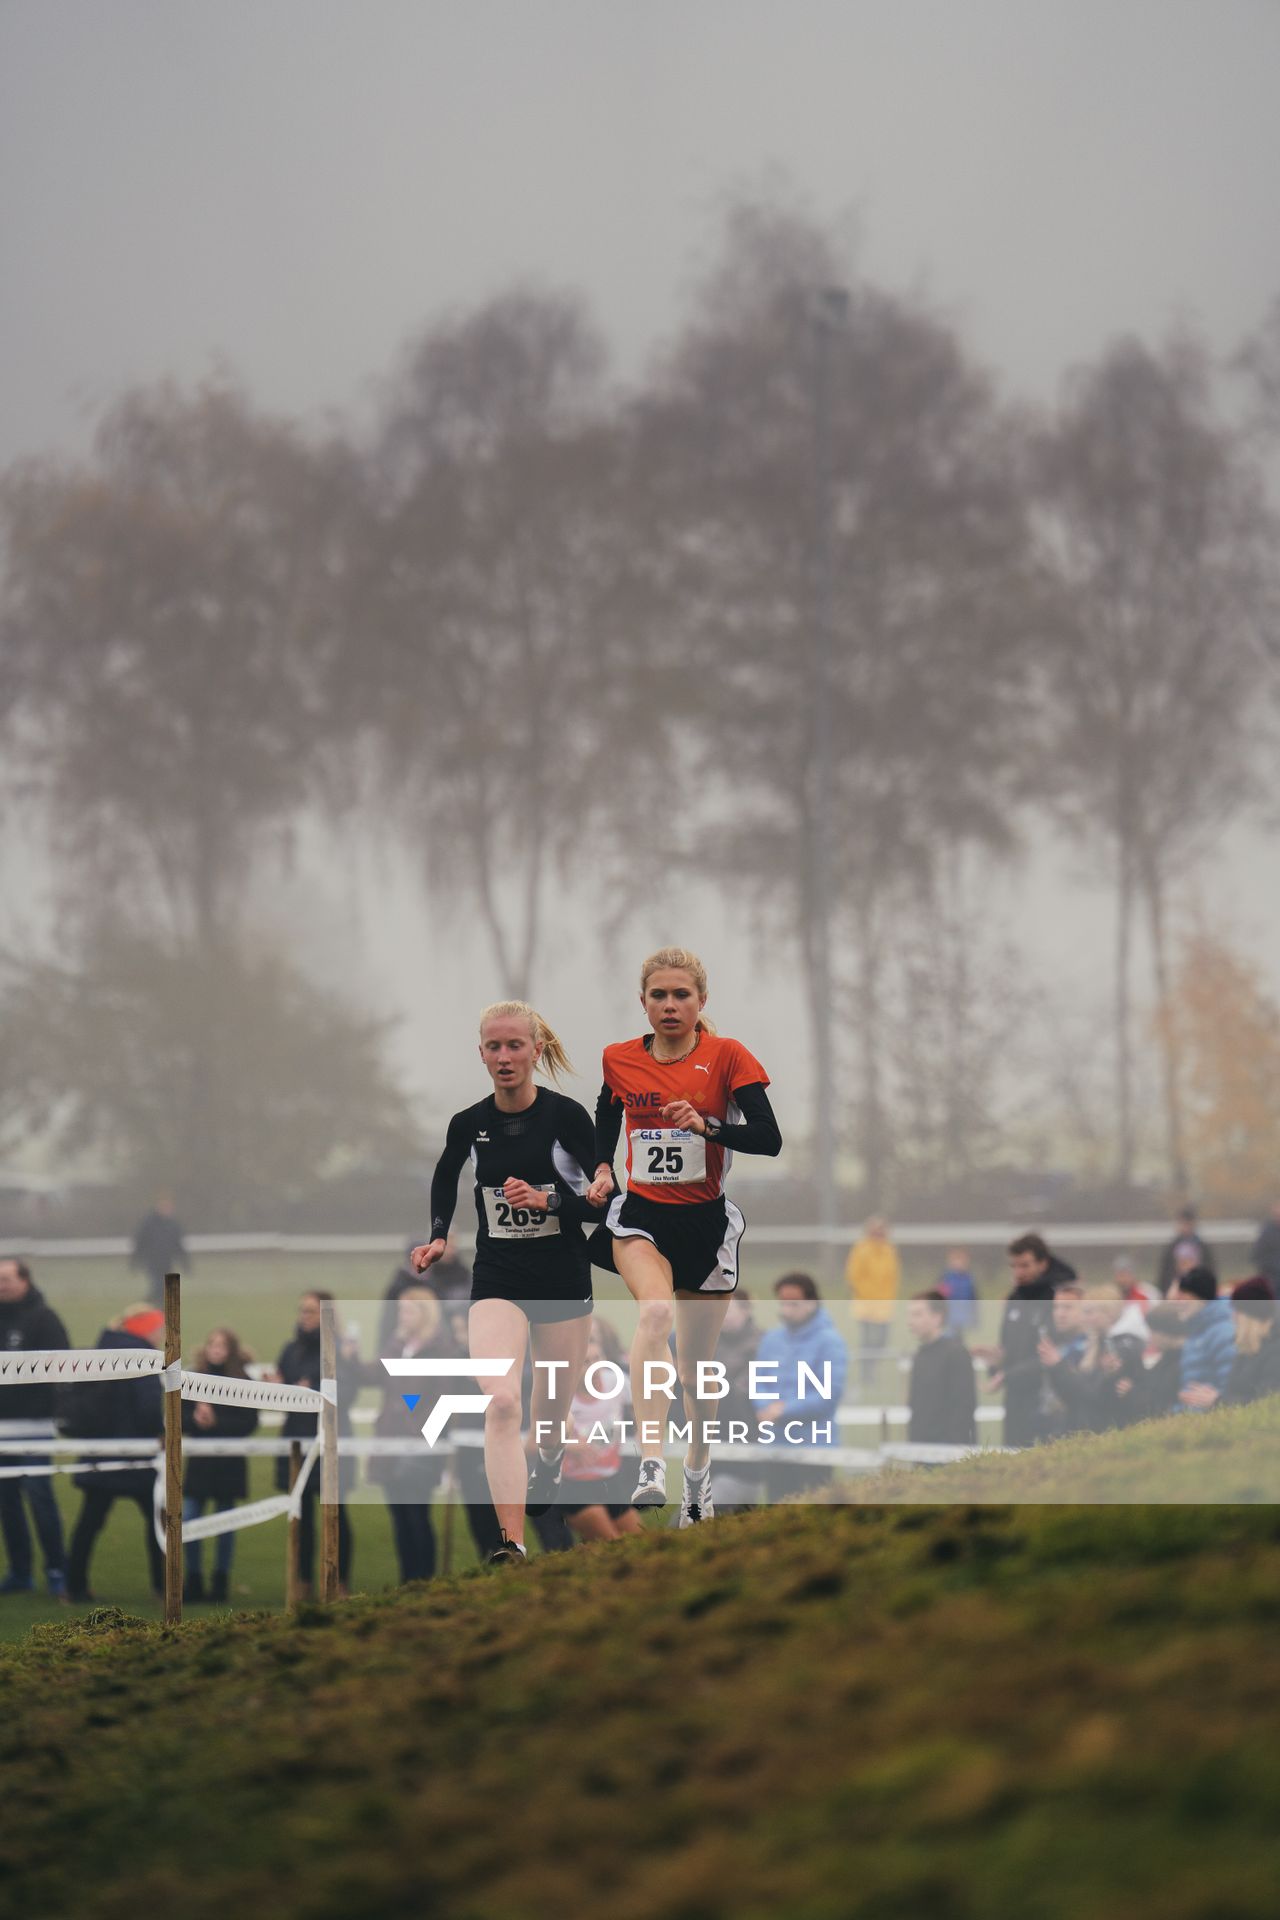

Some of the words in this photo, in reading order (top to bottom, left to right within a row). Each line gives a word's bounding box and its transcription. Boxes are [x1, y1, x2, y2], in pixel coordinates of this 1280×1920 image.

[626, 1092, 661, 1107] SWE
[640, 1131, 662, 1140] GLS
[648, 1146, 683, 1174] 25
[495, 1202, 547, 1227] 269
